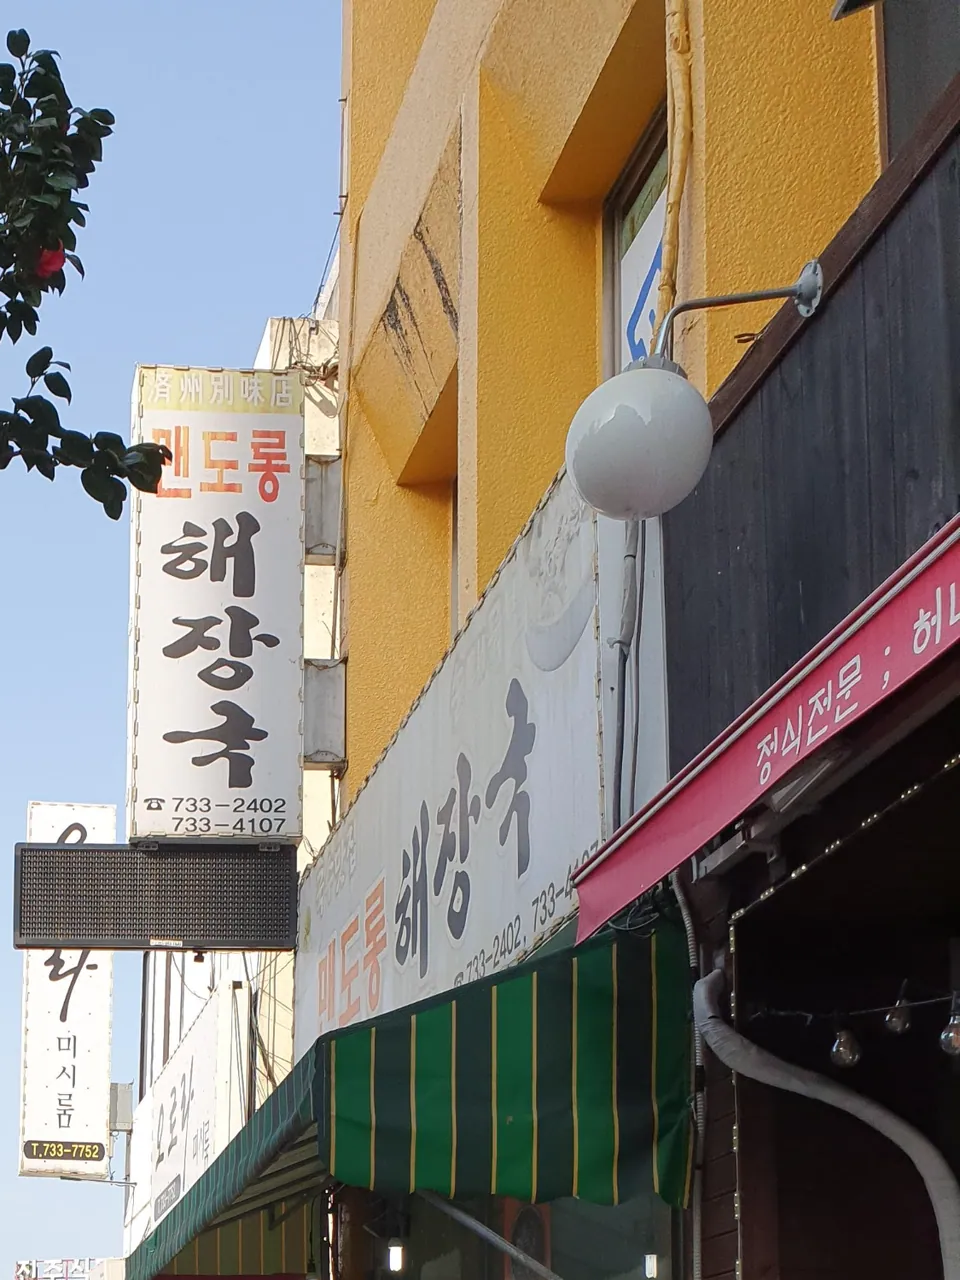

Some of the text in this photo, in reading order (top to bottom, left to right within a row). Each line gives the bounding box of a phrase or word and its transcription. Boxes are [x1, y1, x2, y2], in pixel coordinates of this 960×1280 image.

[160, 511, 280, 788] 해장국
[757, 654, 862, 785] 정식전문
[172, 798, 286, 813] 733-2402
[172, 817, 286, 833] 733-4107
[395, 677, 536, 979] 해장국
[55, 1034, 78, 1129] 미시룸
[30, 1141, 100, 1159] T.733-7752
